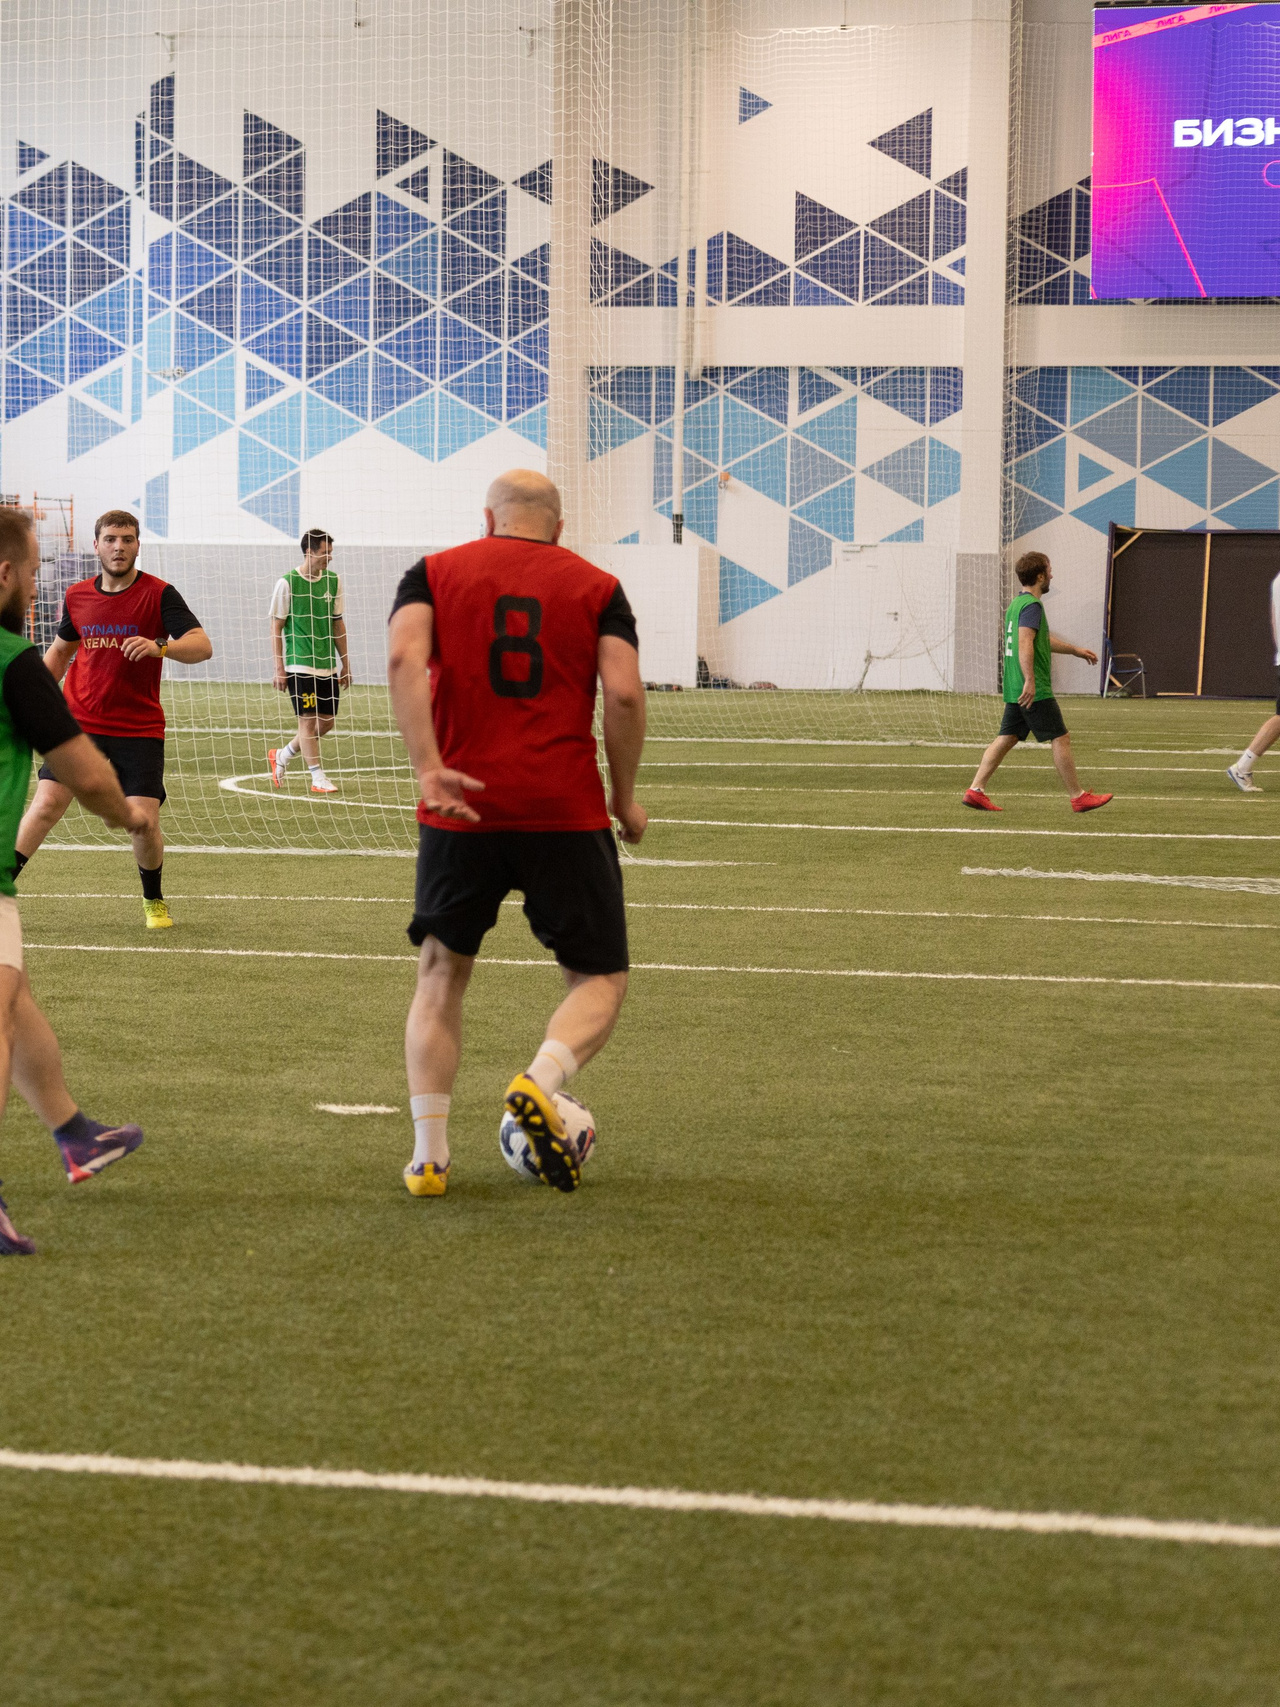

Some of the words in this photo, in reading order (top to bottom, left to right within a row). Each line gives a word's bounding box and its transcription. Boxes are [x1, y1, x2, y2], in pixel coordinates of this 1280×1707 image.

[1156, 15, 1186, 28] ЛИГА
[1102, 29, 1131, 43] ЛИГА
[81, 624, 139, 637] DYNAMO
[489, 594, 543, 699] 8
